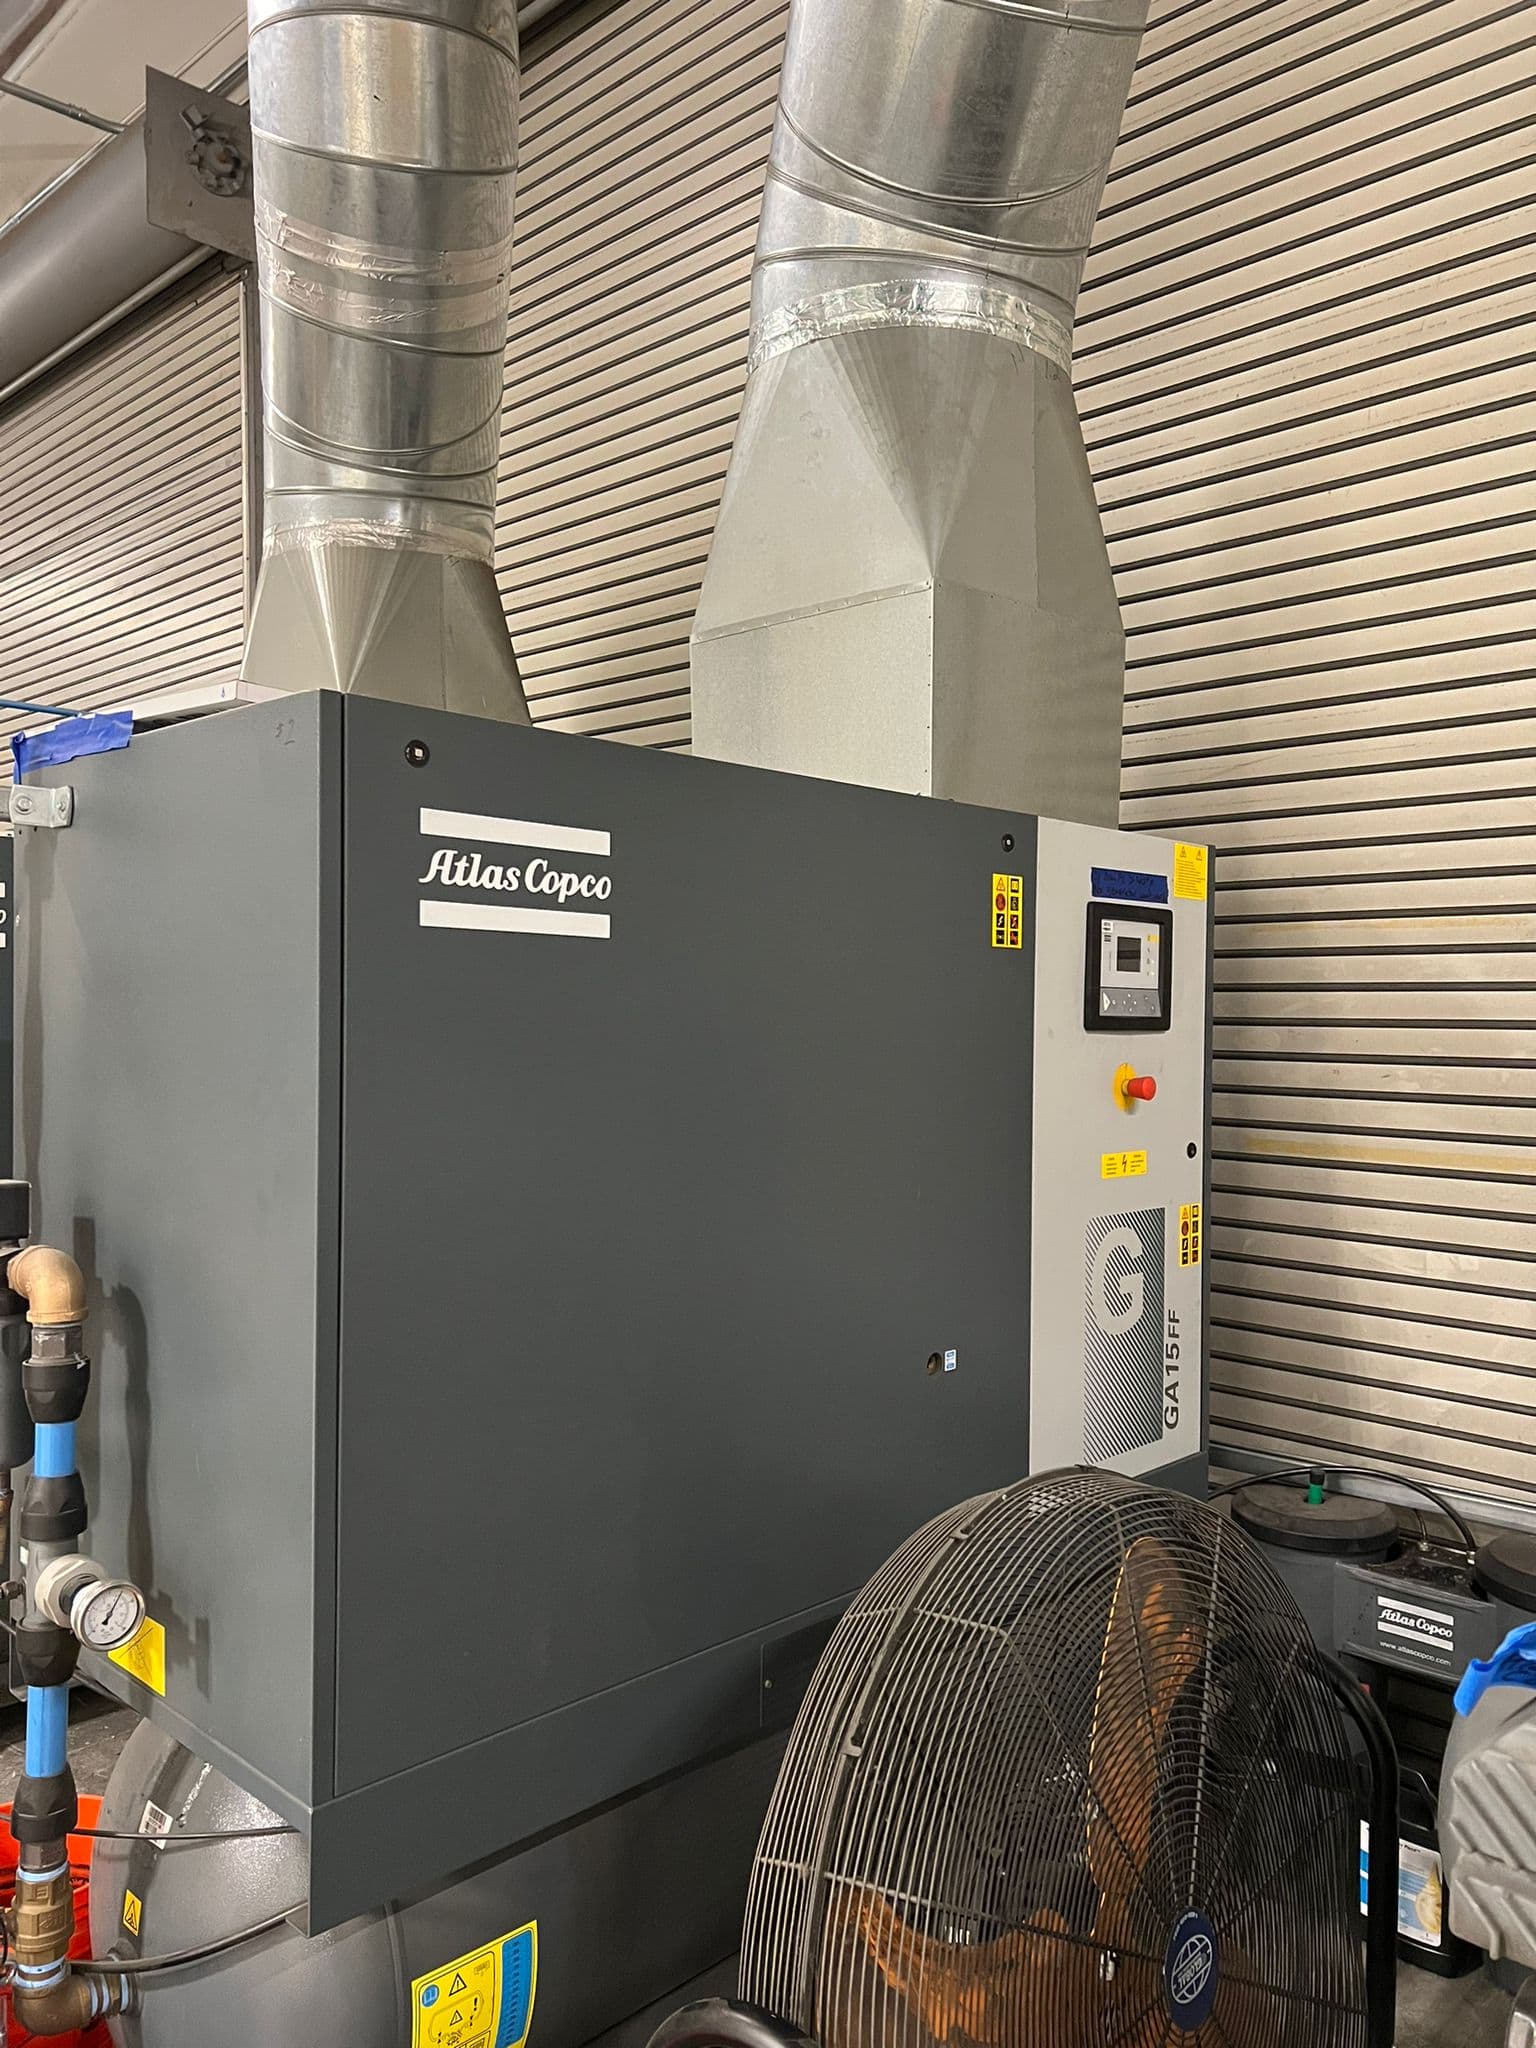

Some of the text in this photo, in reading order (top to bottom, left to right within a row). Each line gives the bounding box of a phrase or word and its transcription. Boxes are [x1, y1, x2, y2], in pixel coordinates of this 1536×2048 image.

[418, 848, 612, 904] Atlas Copco
[1379, 1609, 1453, 1638] Atlas Copco
